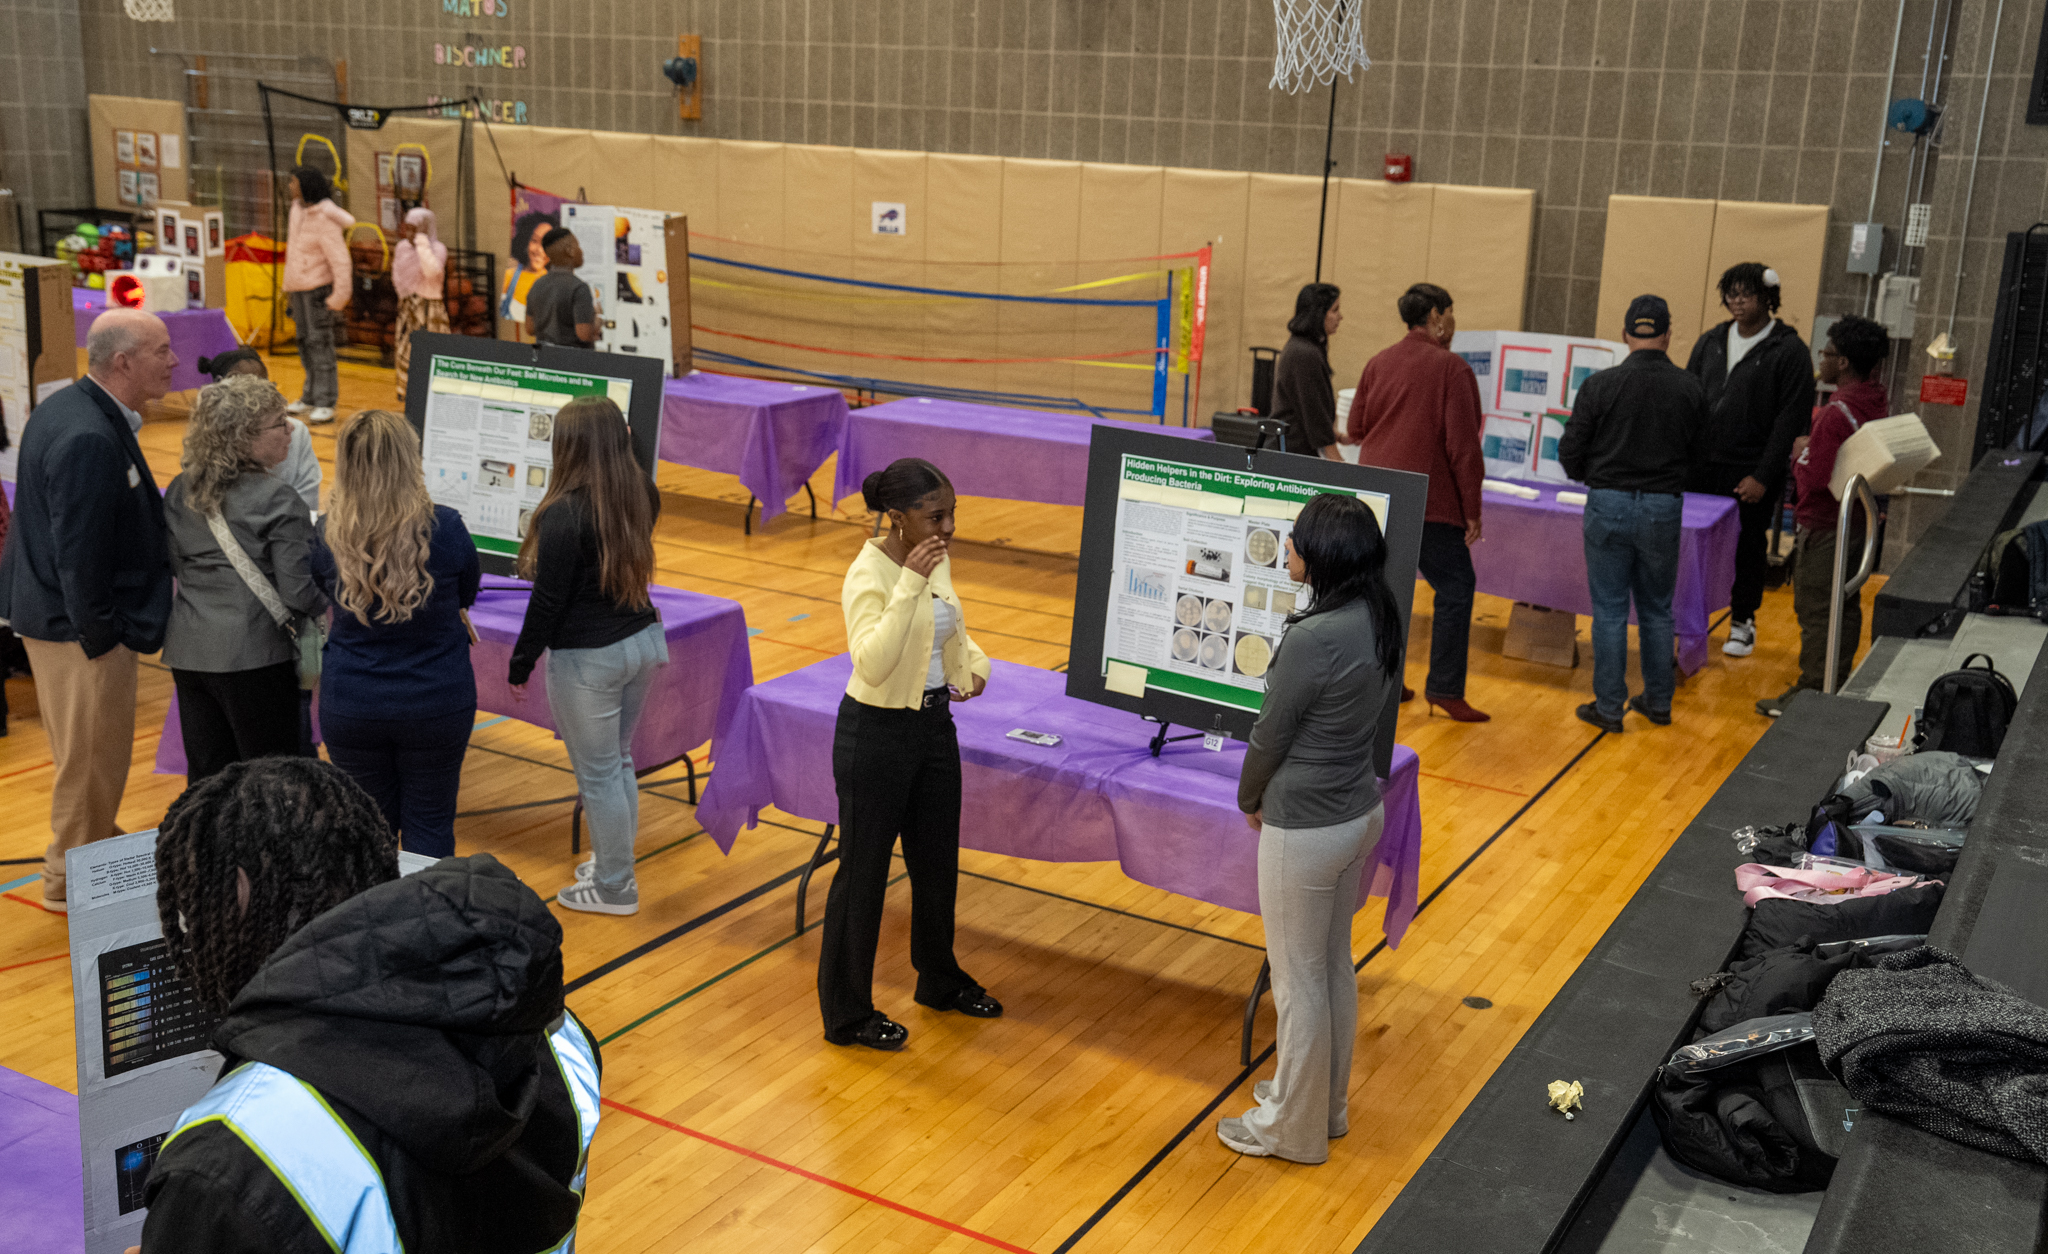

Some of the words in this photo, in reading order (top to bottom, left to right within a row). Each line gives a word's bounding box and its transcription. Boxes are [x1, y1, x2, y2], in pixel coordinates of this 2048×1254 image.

[437, 359, 449, 368] The
[524, 370, 538, 379] Soil
[538, 372, 567, 384] Microbes
[568, 377, 581, 385] and
[582, 378, 594, 387] the
[484, 375, 519, 387] Antibiotics
[1125, 470, 1167, 487] Producing
[1168, 477, 1203, 491] Bacteria
[1127, 459, 1155, 471] Hidden
[1156, 463, 1188, 477] Helpers
[1189, 468, 1197, 478] in
[1199, 470, 1213, 480] the
[1214, 472, 1233, 484] Dirt:
[1234, 475, 1276, 492] Exploring
[1206, 737, 1218, 747] G12
